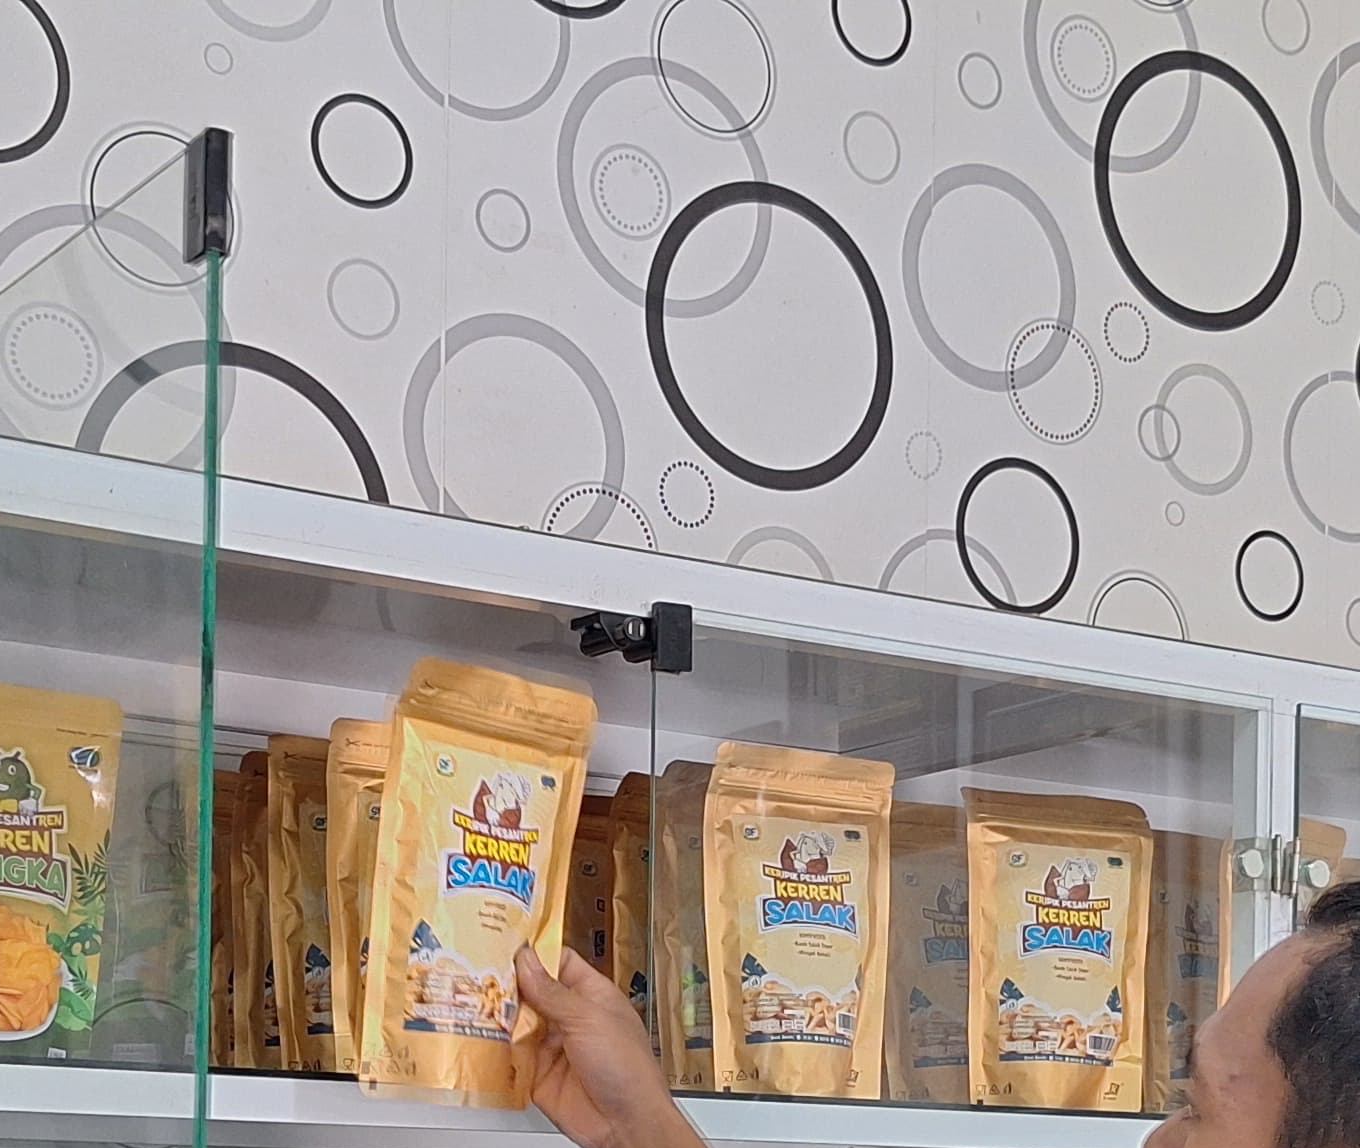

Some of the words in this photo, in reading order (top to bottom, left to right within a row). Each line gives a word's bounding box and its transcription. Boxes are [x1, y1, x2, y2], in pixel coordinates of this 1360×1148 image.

[464, 832, 531, 866] KERREN
[448, 856, 536, 899] SALAK
[776, 880, 843, 902] KERREN
[764, 900, 856, 933] SALAK
[1038, 906, 1102, 928] KERREN
[1025, 926, 1111, 957] SALAK
